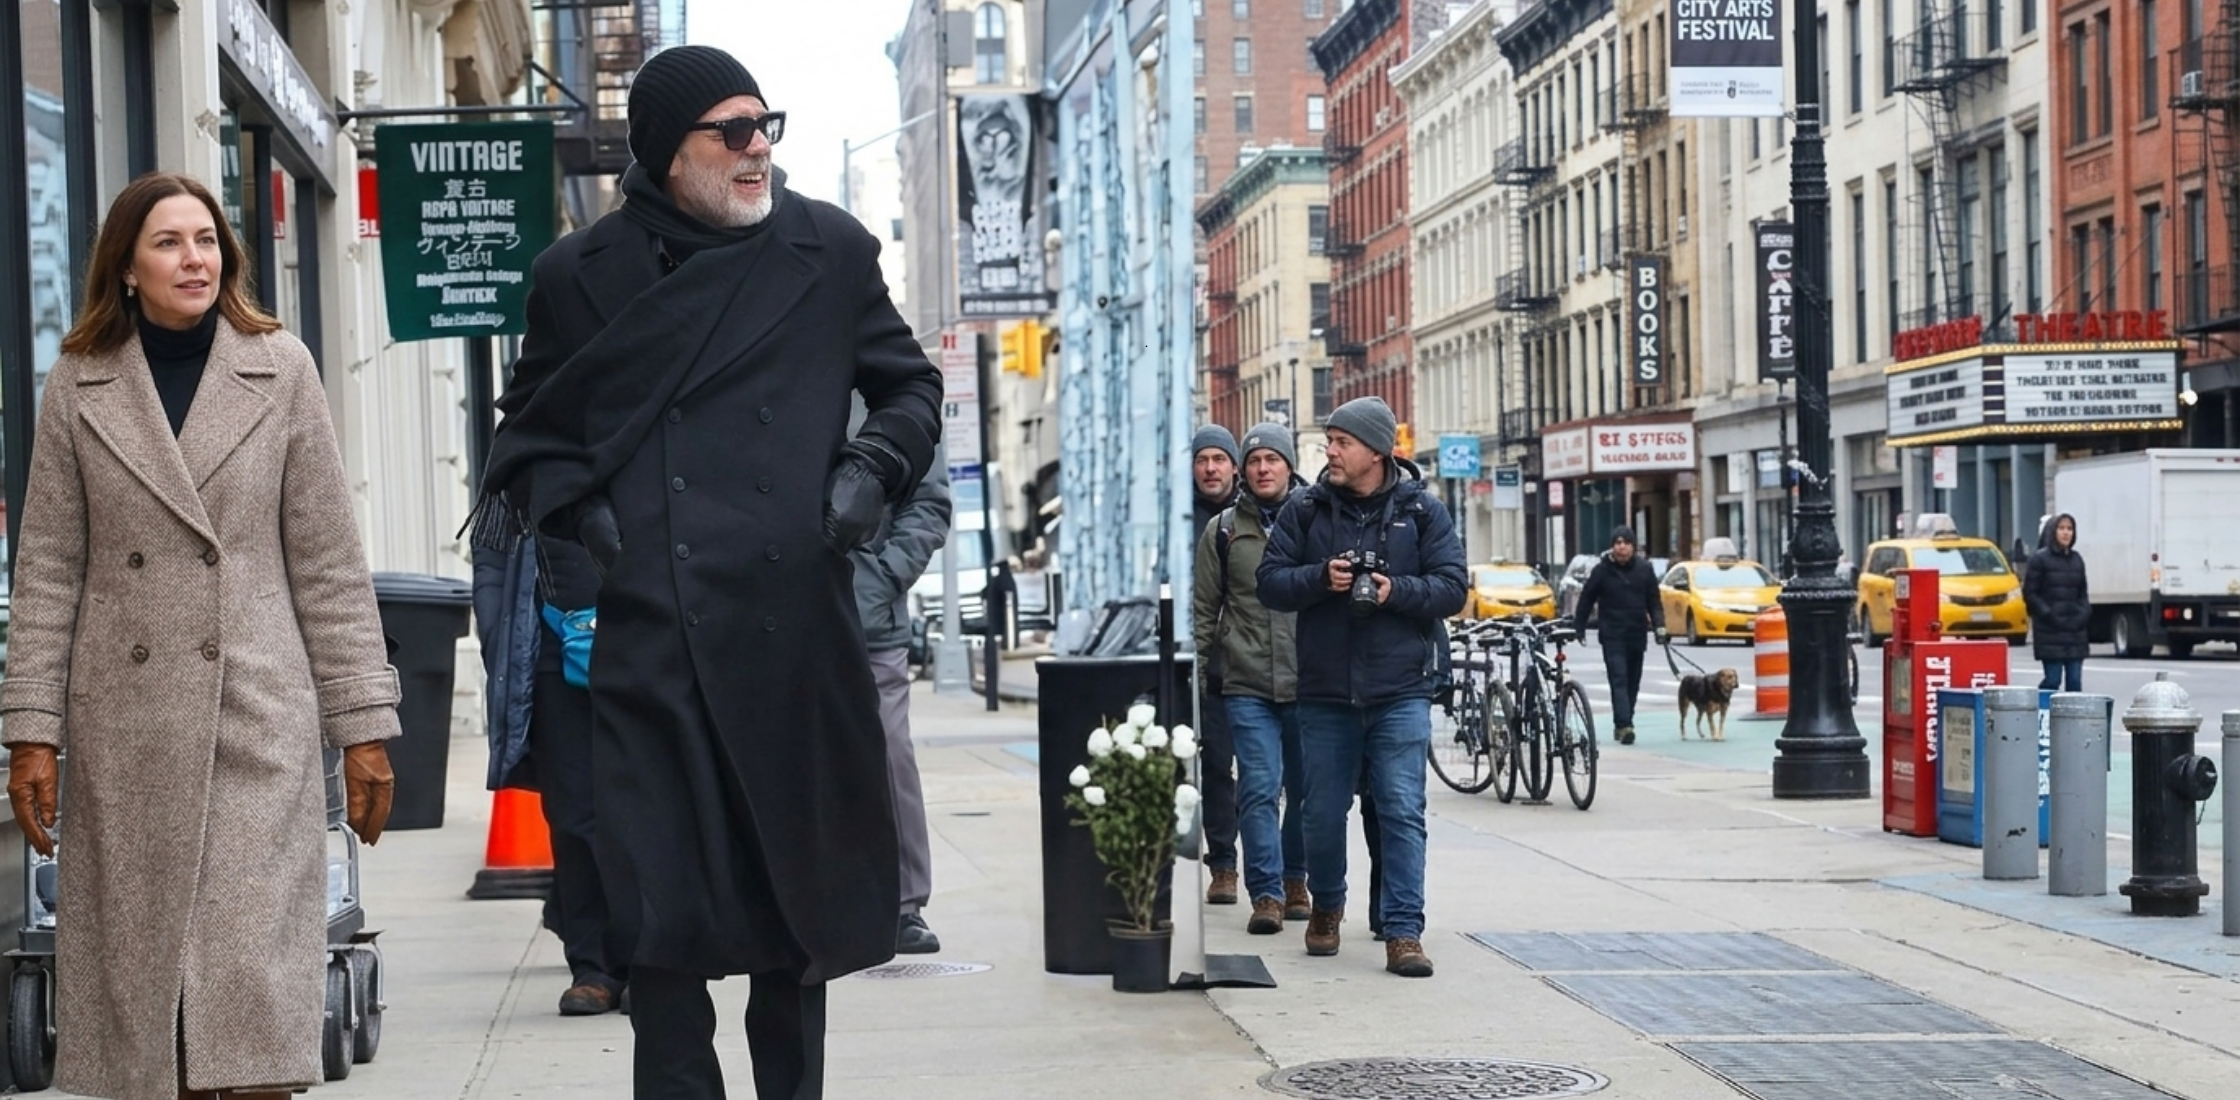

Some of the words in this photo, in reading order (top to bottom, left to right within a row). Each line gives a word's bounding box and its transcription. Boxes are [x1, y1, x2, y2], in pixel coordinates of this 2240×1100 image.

[1677, 0, 1720, 18] CITY
[1724, 0, 1774, 18] ARTS
[1677, 19, 1775, 40] FESTIVAL
[410, 140, 524, 173] VINTAGE
[1637, 266, 1659, 380] BOOKS
[2013, 310, 2168, 344] THEATRE
